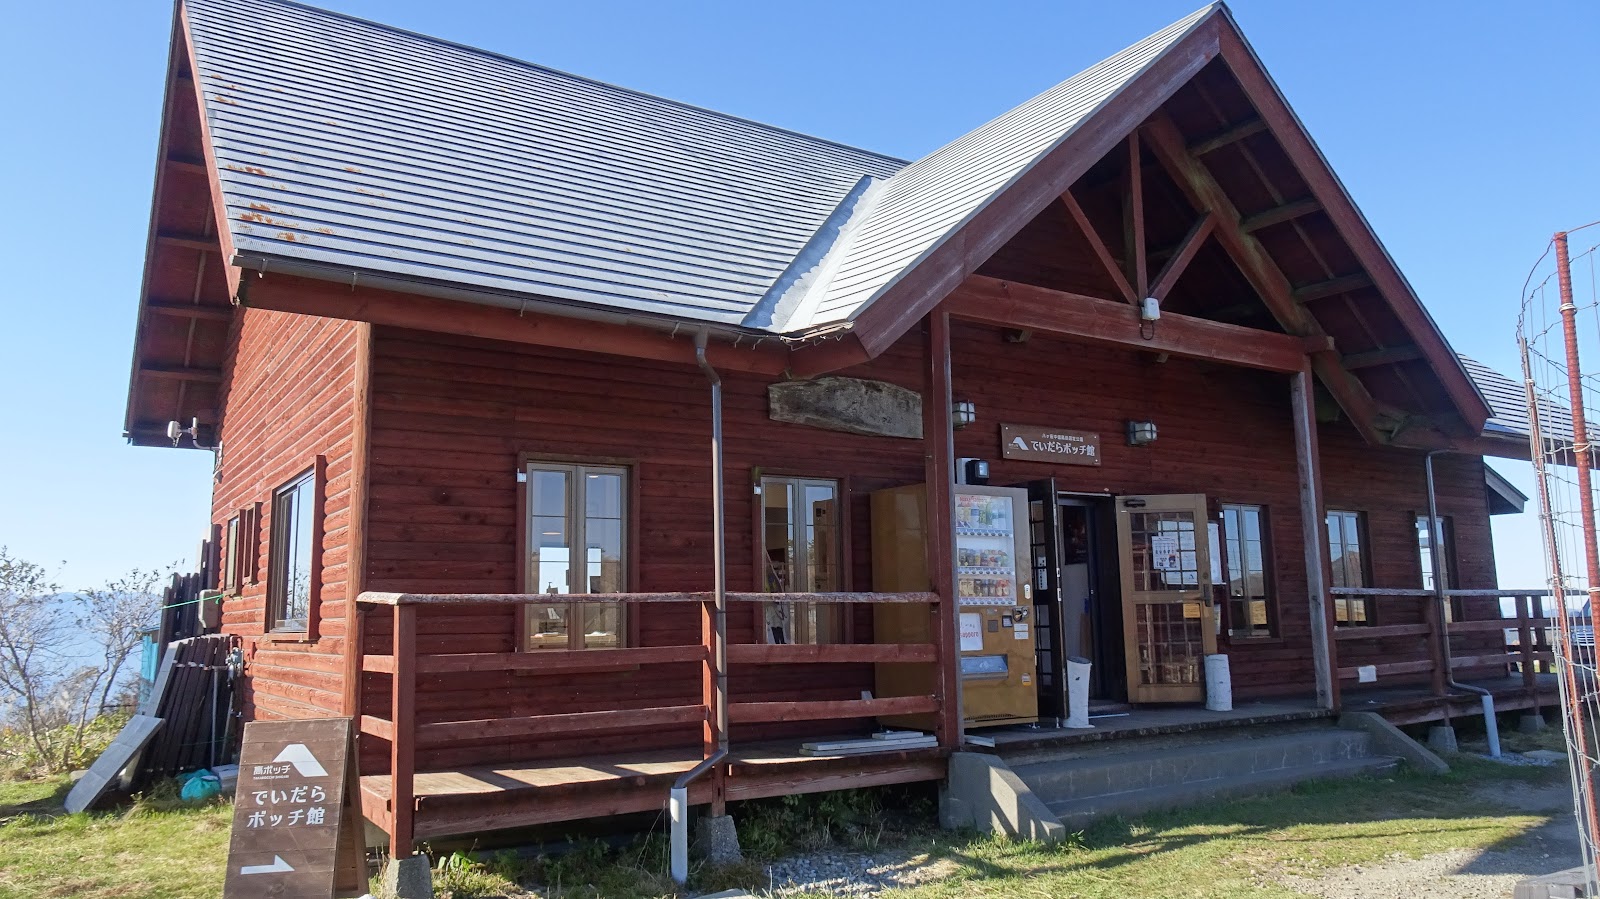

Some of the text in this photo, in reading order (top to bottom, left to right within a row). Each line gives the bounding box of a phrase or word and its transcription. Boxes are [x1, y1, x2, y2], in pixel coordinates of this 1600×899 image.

[1031, 440, 1095, 457] でいだらボッチ館
[253, 764, 290, 775] 高ボッチ
[252, 785, 326, 805] でいだら
[246, 806, 326, 828] ボッチ館
